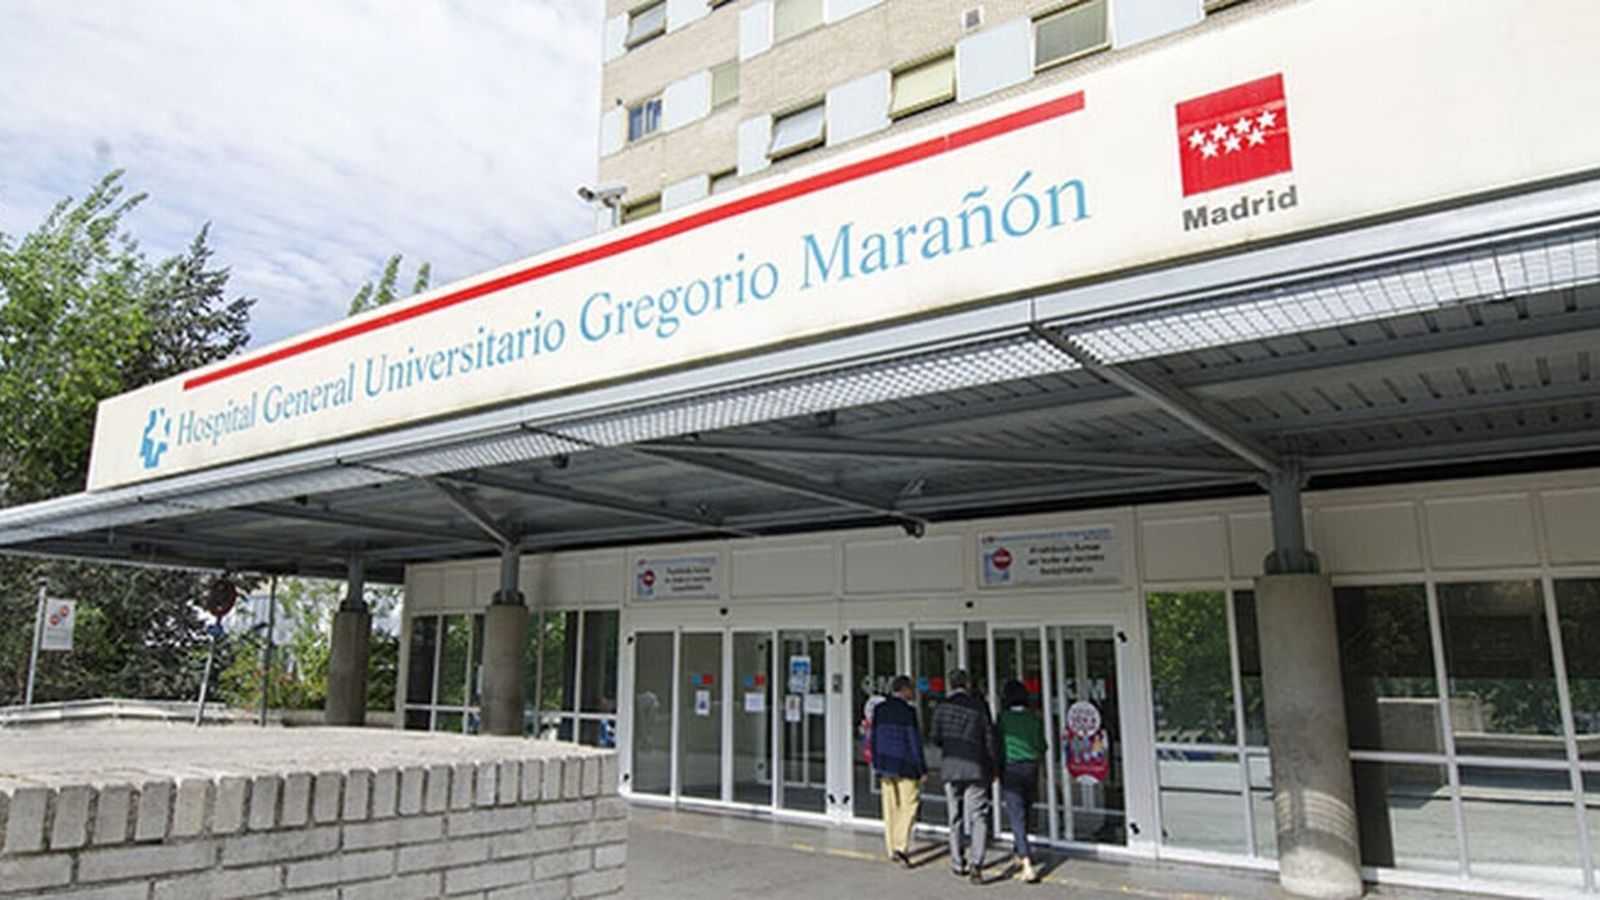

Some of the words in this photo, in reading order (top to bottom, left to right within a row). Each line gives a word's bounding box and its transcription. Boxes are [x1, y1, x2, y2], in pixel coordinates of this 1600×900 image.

[1182, 184, 1299, 232] Madrid
[177, 391, 258, 446] Hospital
[263, 363, 356, 424] General
[364, 325, 566, 397] Universitario
[579, 253, 780, 343] Gregorio
[800, 173, 1091, 290] Marañón
